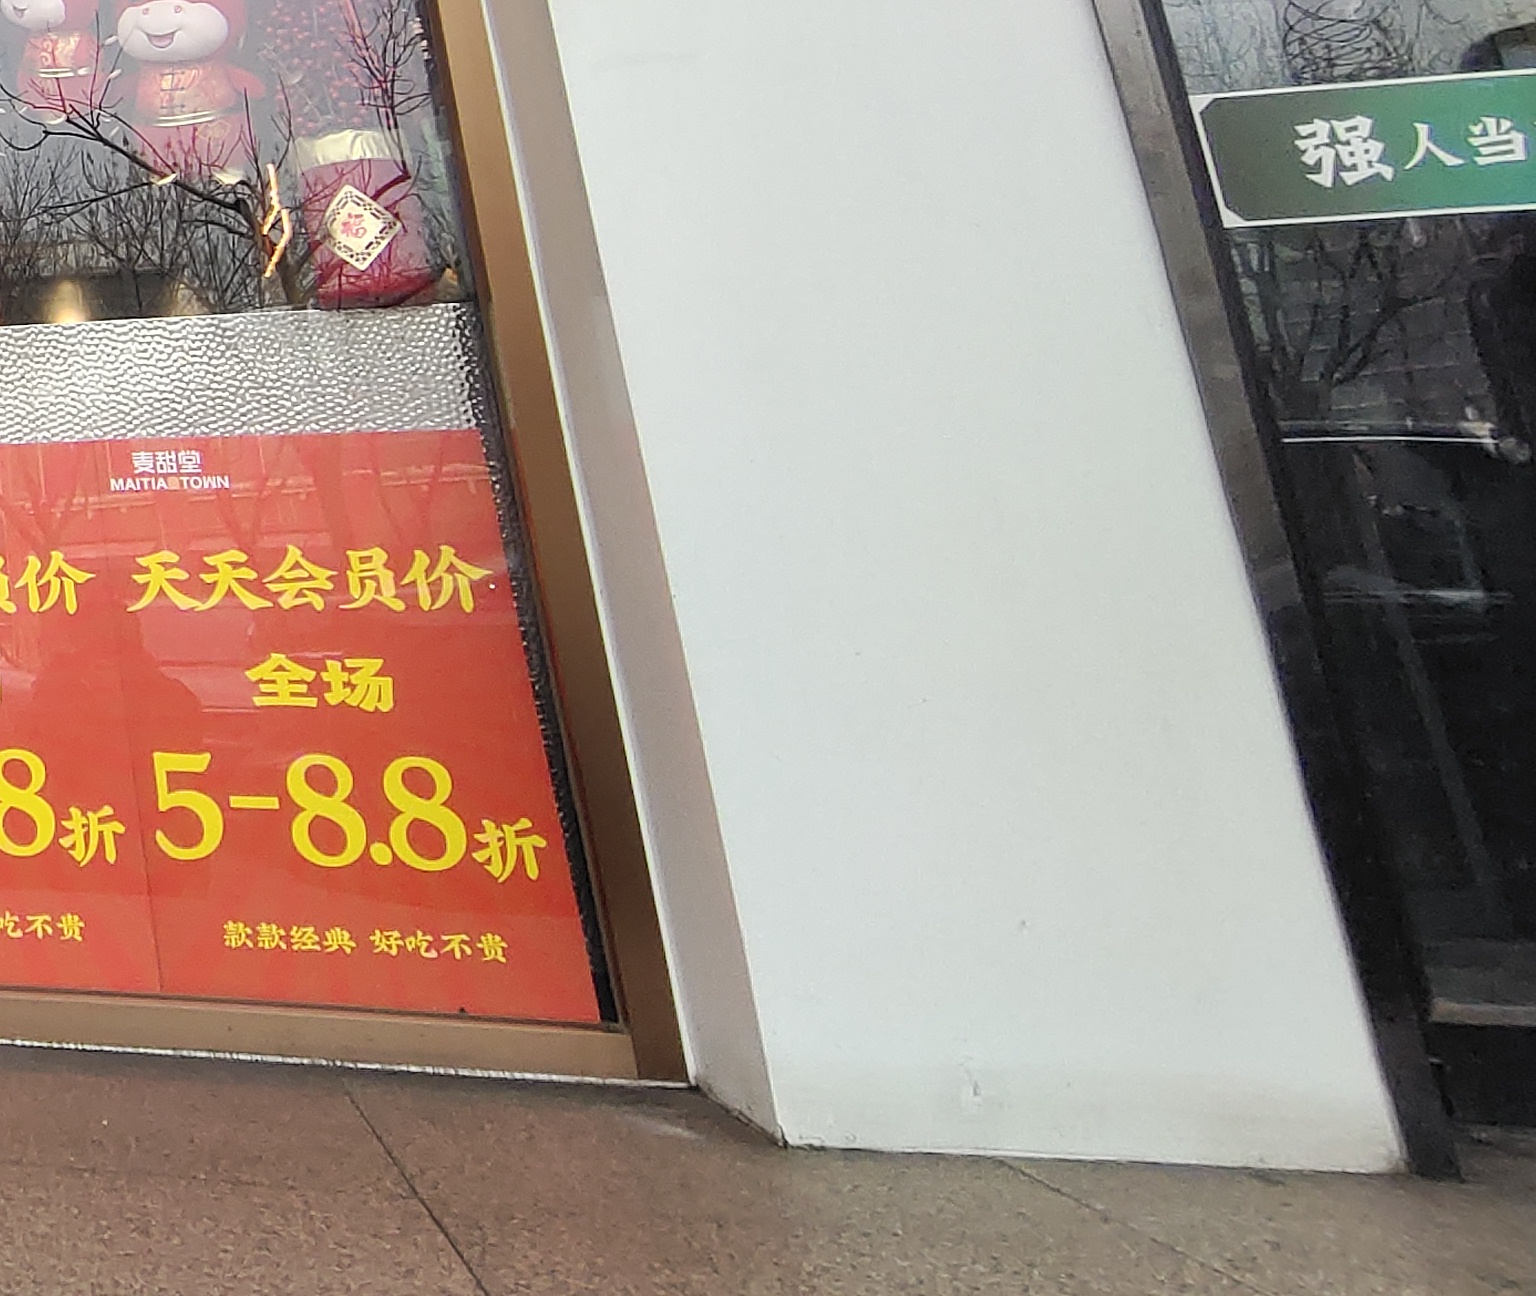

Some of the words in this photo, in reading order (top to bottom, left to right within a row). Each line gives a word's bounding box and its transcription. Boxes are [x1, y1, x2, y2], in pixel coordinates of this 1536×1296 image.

[1294, 115, 1535, 188] 强人当
[110, 476, 168, 492] MAITIA
[179, 475, 230, 490] TOWN
[131, 450, 202, 474] 麦甜堂
[127, 544, 494, 614] 天天会员价
[245, 653, 395, 713] 全场
[153, 750, 548, 883] 5-8.8折
[223, 920, 357, 955] 款款经典
[369, 924, 508, 964] 好吃不贵
